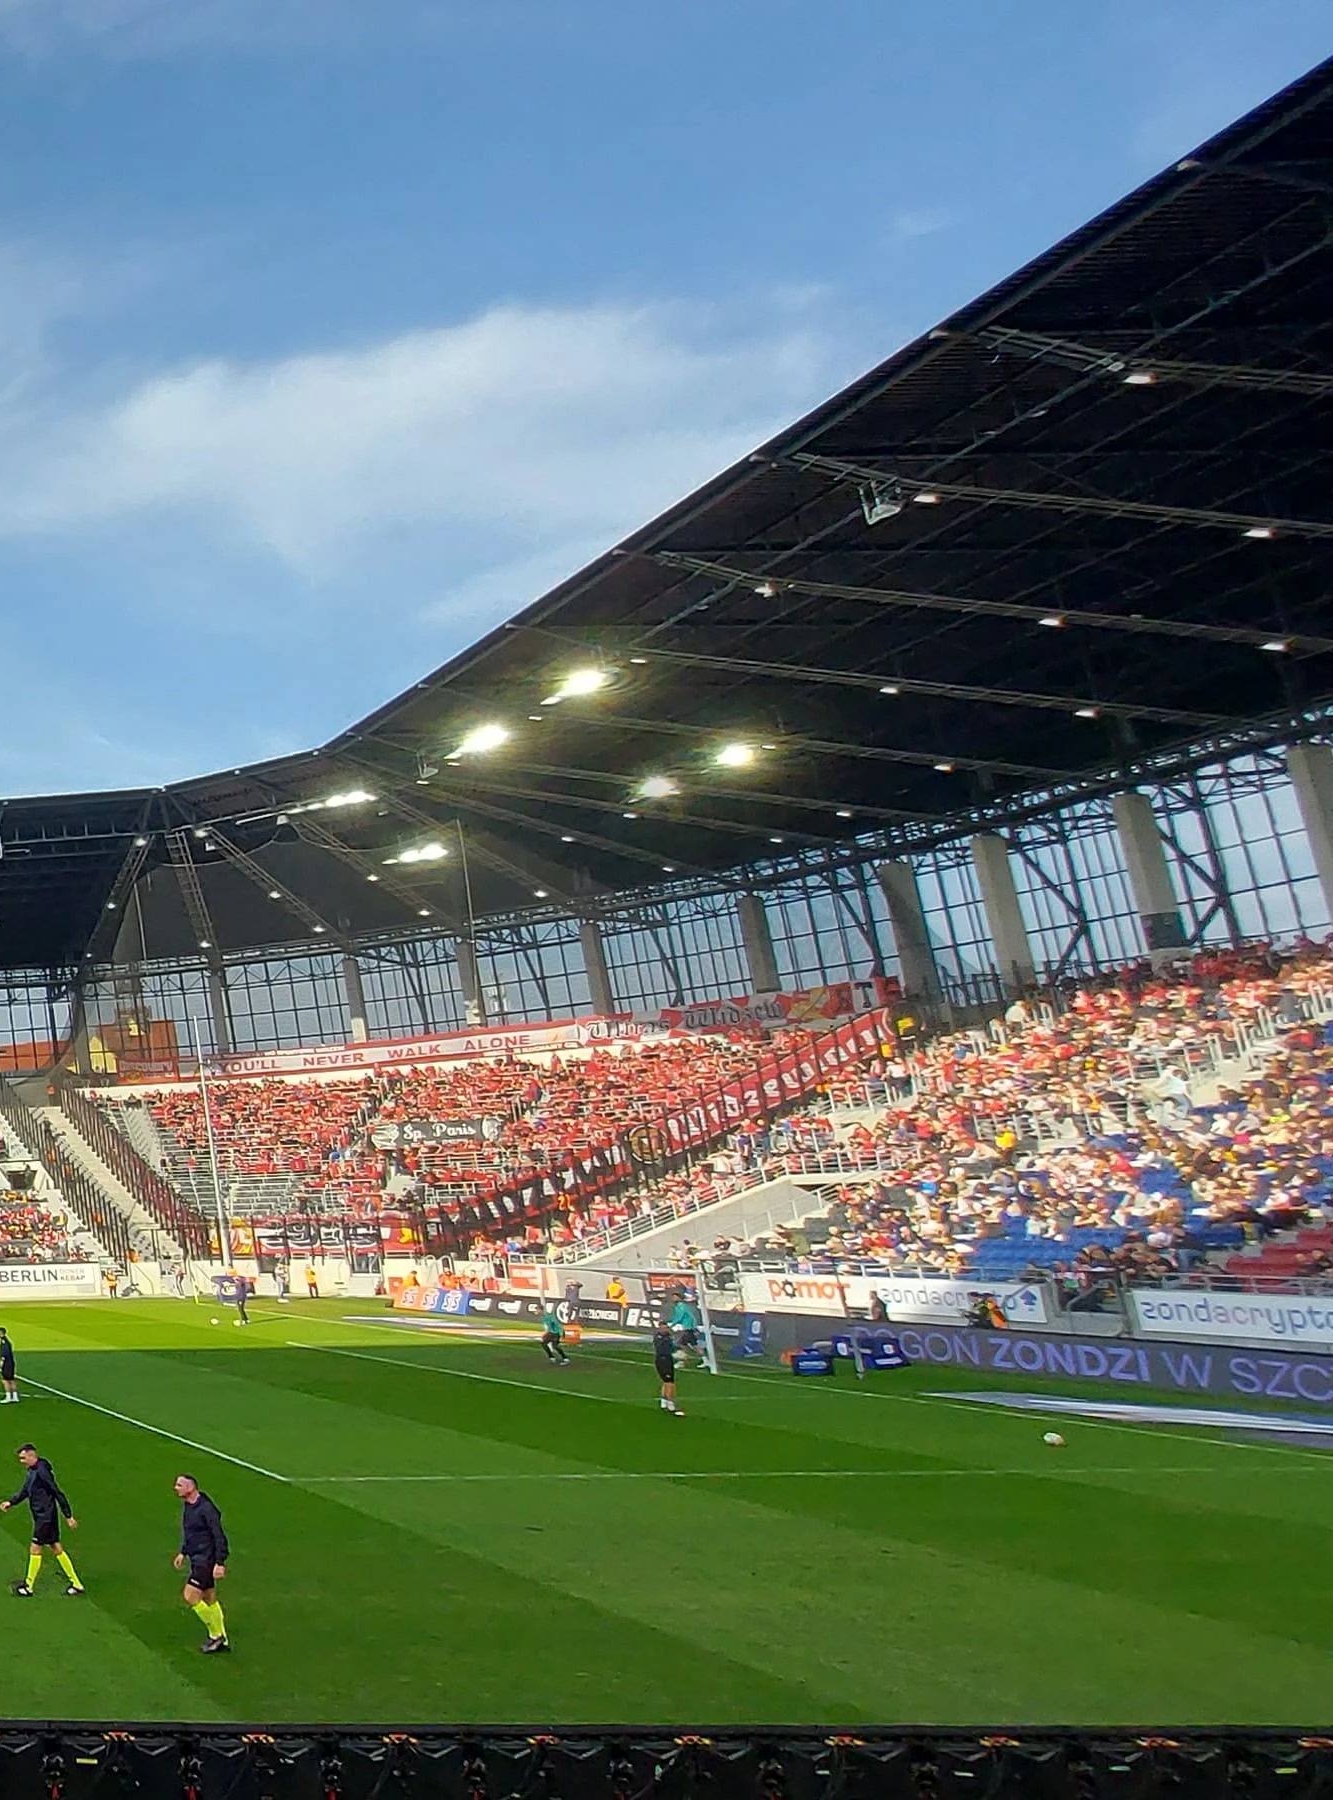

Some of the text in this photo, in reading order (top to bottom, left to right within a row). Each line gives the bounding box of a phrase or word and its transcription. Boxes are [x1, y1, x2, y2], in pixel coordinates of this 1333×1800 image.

[221, 1034, 531, 1073] YOU'LL NEVER WALK ALONE
[432, 1123, 477, 1138] Paris
[988, 1336, 1151, 1383] ZONDZI
[1160, 1351, 1213, 1389] W
